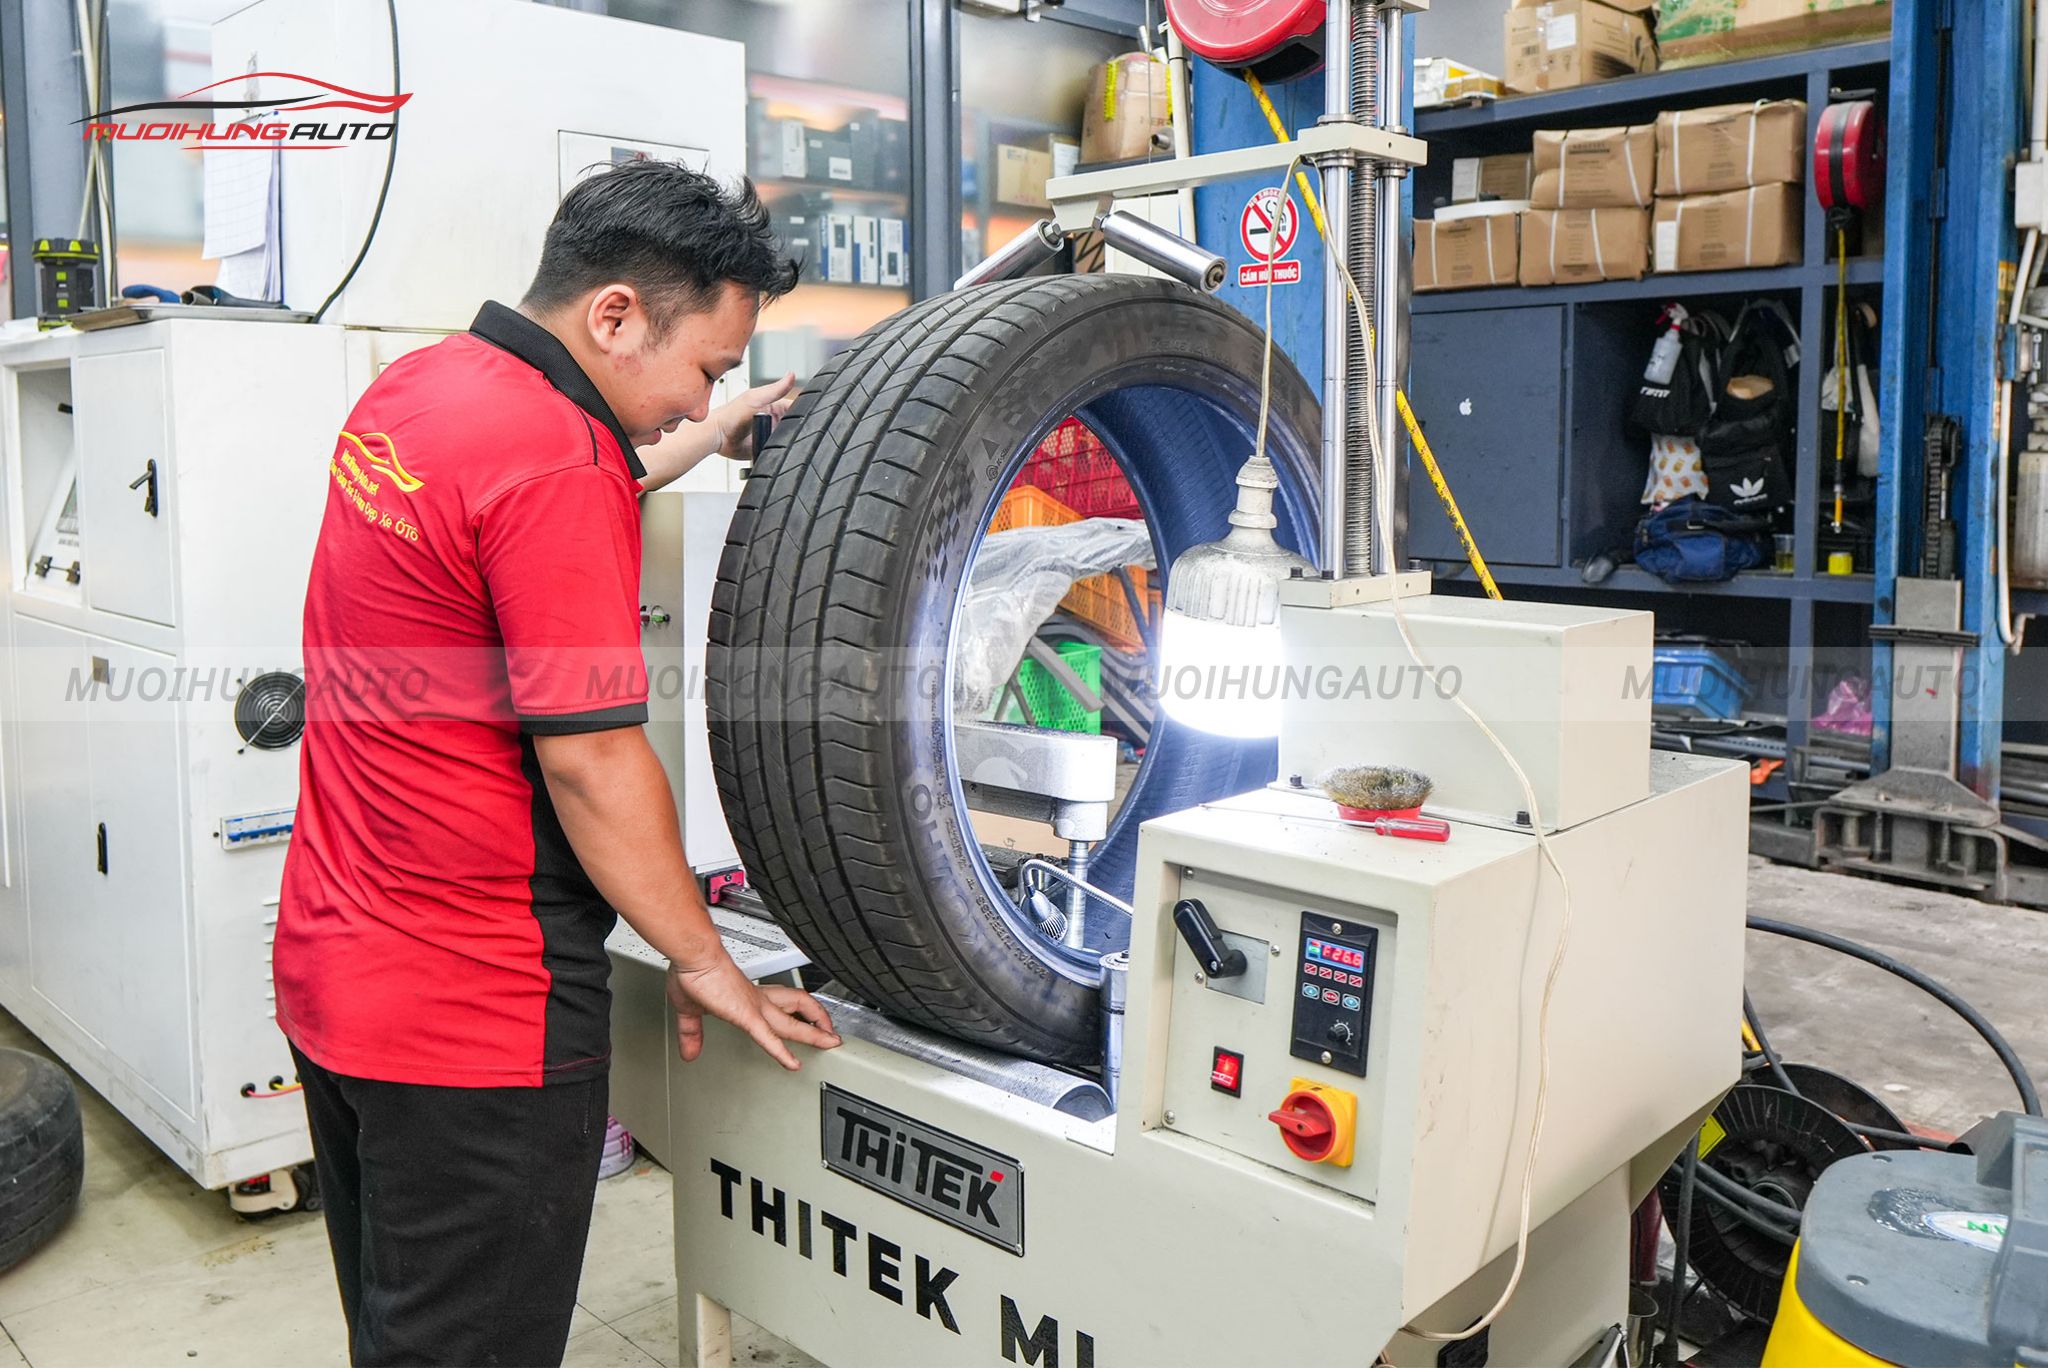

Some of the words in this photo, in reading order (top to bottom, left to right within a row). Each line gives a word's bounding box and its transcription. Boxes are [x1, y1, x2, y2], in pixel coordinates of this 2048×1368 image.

[1258, 266, 1271, 282] HÚ
[378, 512, 393, 528] Xe
[710, 1157, 962, 1336] THITEK
